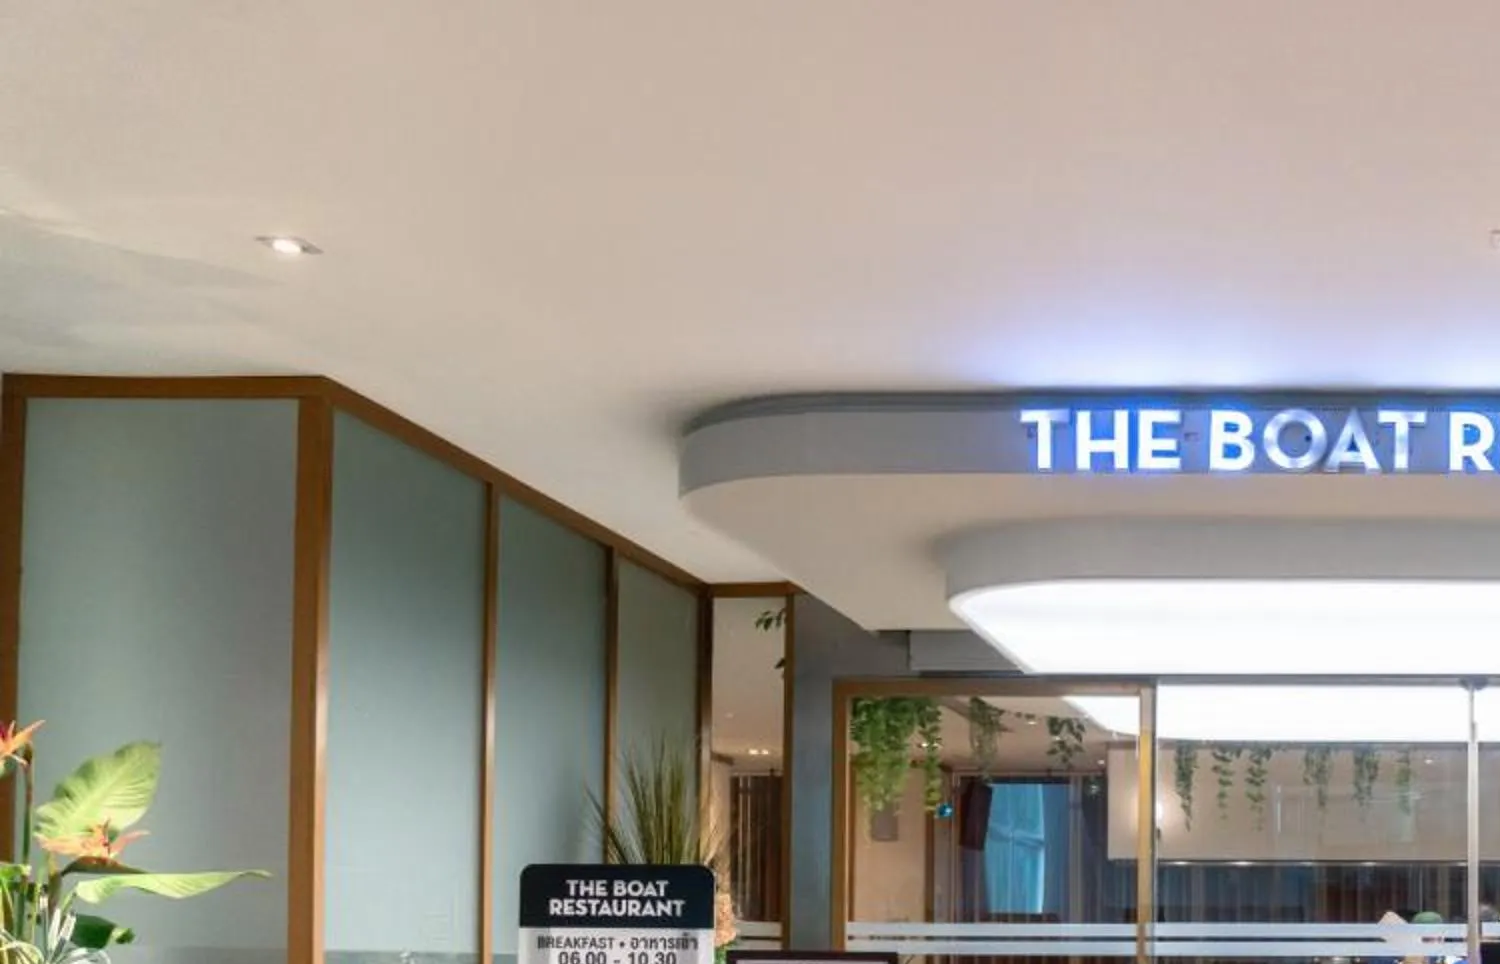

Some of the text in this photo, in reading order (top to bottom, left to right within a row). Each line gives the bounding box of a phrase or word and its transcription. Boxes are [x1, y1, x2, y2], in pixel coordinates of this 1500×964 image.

[1019, 407, 1182, 473] THE
[1208, 407, 1428, 474] BOAT
[566, 879, 668, 897] THE BOAT
[550, 899, 685, 917] RESTAURANT
[537, 932, 698, 950] BREAKFAST อาหารเช้า
